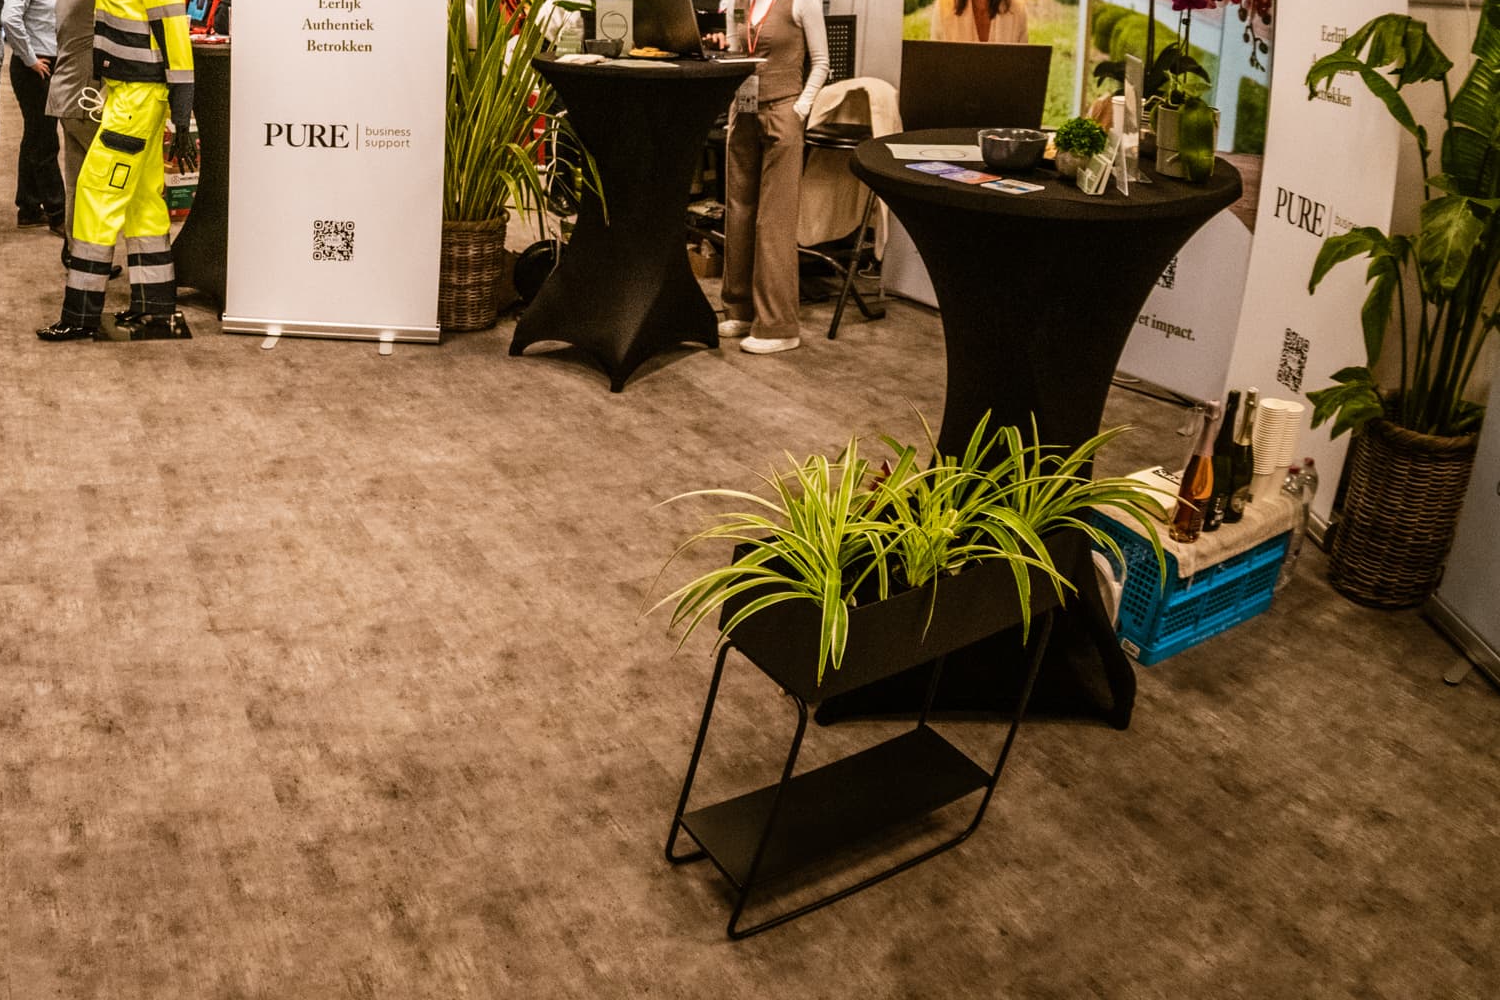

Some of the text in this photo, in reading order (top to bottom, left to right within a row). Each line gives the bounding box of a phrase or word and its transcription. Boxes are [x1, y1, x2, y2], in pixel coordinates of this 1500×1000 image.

[302, 17, 374, 31] Authentiek
[307, 39, 373, 53] Betrokken
[263, 122, 350, 149] PURE
[365, 126, 412, 137] business
[365, 138, 411, 149] support
[1273, 186, 1326, 238] PURE
[1150, 314, 1196, 341] impact.
